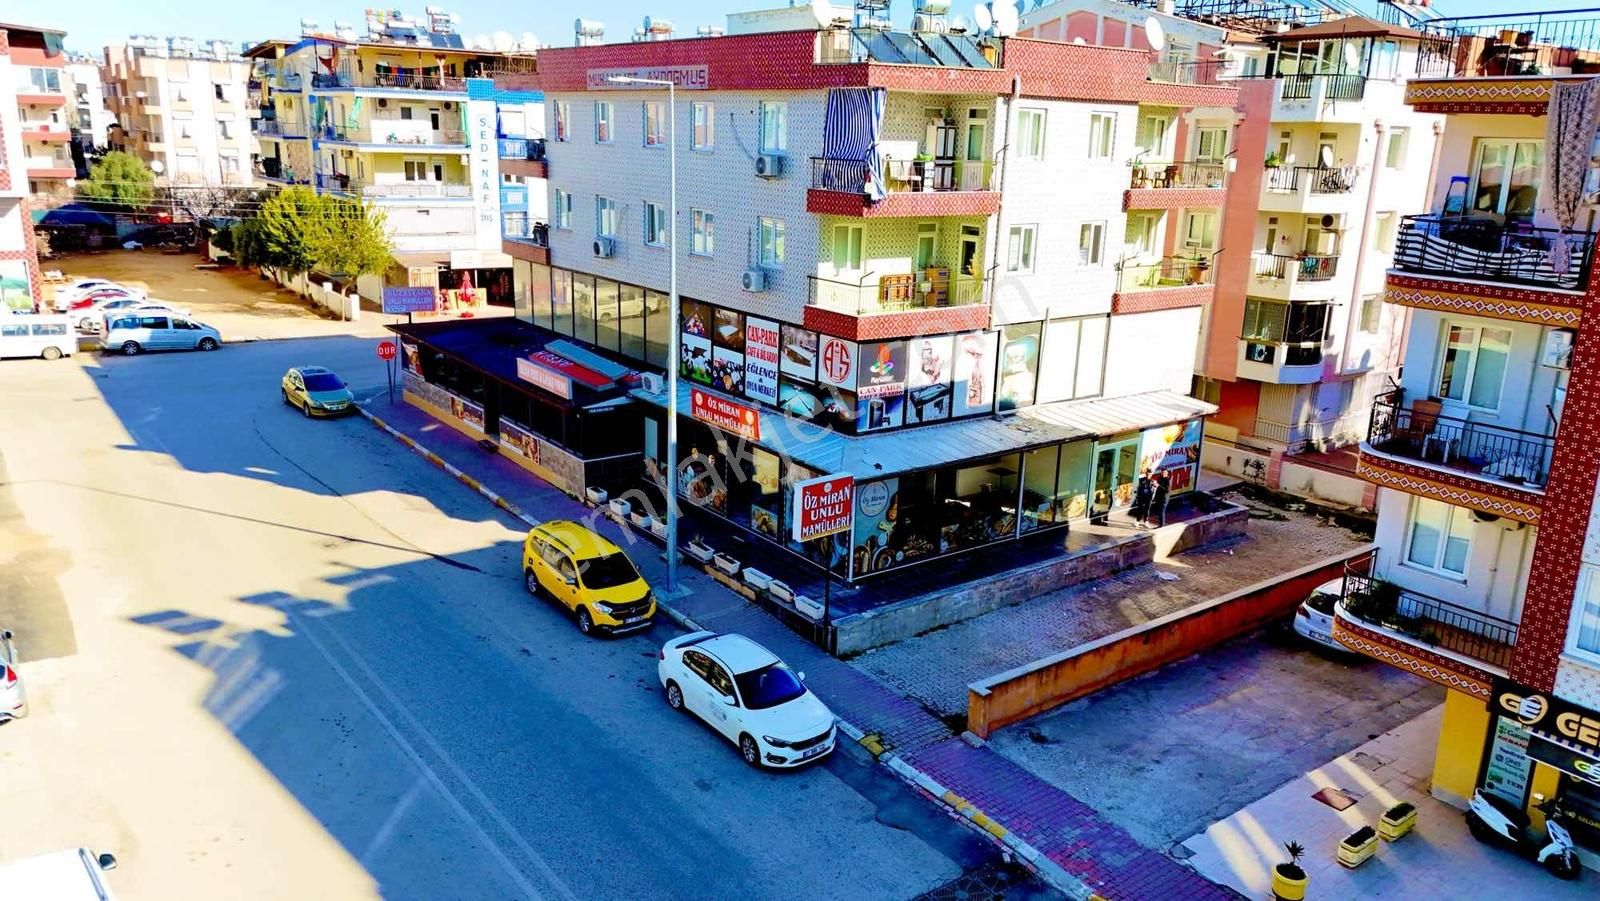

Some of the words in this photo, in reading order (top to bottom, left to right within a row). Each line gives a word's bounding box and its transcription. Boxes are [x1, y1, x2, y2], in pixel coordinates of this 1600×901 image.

[747, 325, 778, 348] CAN-PARK
[378, 347, 396, 355] DUR
[747, 363, 777, 380] EĞLENCE
[860, 384, 902, 394] CAN-PARK
[695, 406, 713, 420] UNLU
[707, 397, 717, 409] ÖZ
[718, 402, 740, 417] MİRAN
[804, 491, 818, 510] ÖZ
[820, 484, 851, 506] MİRAN
[810, 503, 843, 521] UNLU
[802, 512, 851, 536] MAMÜLLERİ
